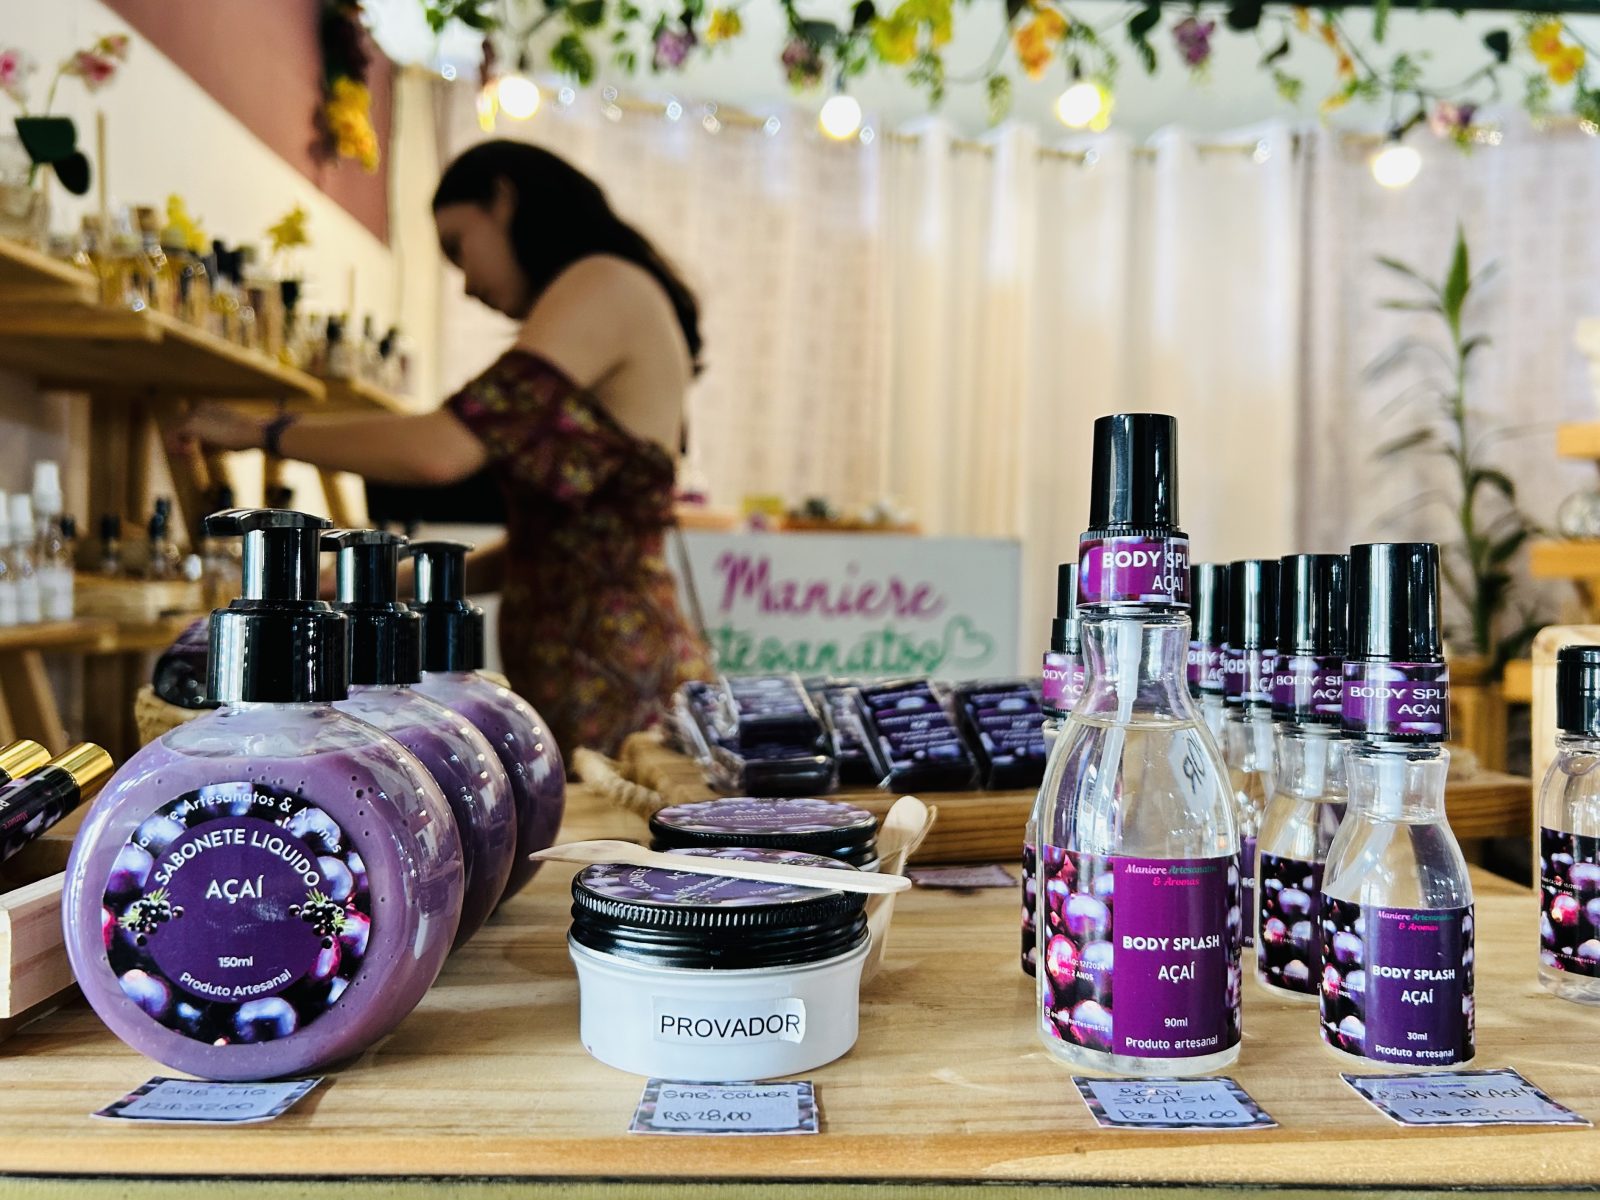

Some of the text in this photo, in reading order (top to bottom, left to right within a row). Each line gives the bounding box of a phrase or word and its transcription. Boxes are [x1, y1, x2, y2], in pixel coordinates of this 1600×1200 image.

[1102, 550, 1190, 570] BODY SPL
[714, 551, 945, 621] Maniere
[704, 624, 944, 674] tesanatos
[1043, 669, 1068, 680] ODY
[1276, 675, 1319, 686] BODY
[1350, 686, 1405, 699] BODY
[279, 796, 292, 813] &
[153, 828, 320, 888] SABONETE LIQUIDO
[1124, 863, 1167, 874] Maniere
[205, 874, 265, 904] AÇAÍ
[1164, 877, 1200, 886] Aromas
[1377, 910, 1411, 920] Maniere
[1122, 934, 1220, 951] BODY SPLASH
[218, 955, 254, 968] 150ml
[1158, 961, 1195, 984] AÇAÍ
[1372, 964, 1456, 981] BODY SPLASH
[180, 968, 292, 997] Produto Artesanal
[1401, 988, 1434, 1006] AÇAÍ
[661, 1014, 800, 1038] PROVADOR
[1164, 1017, 1188, 1028] 90ml
[1125, 1034, 1218, 1050] Produto artesanal
[1407, 1031, 1428, 1041] 30ml
[1375, 1044, 1454, 1059] Produto artesanal
